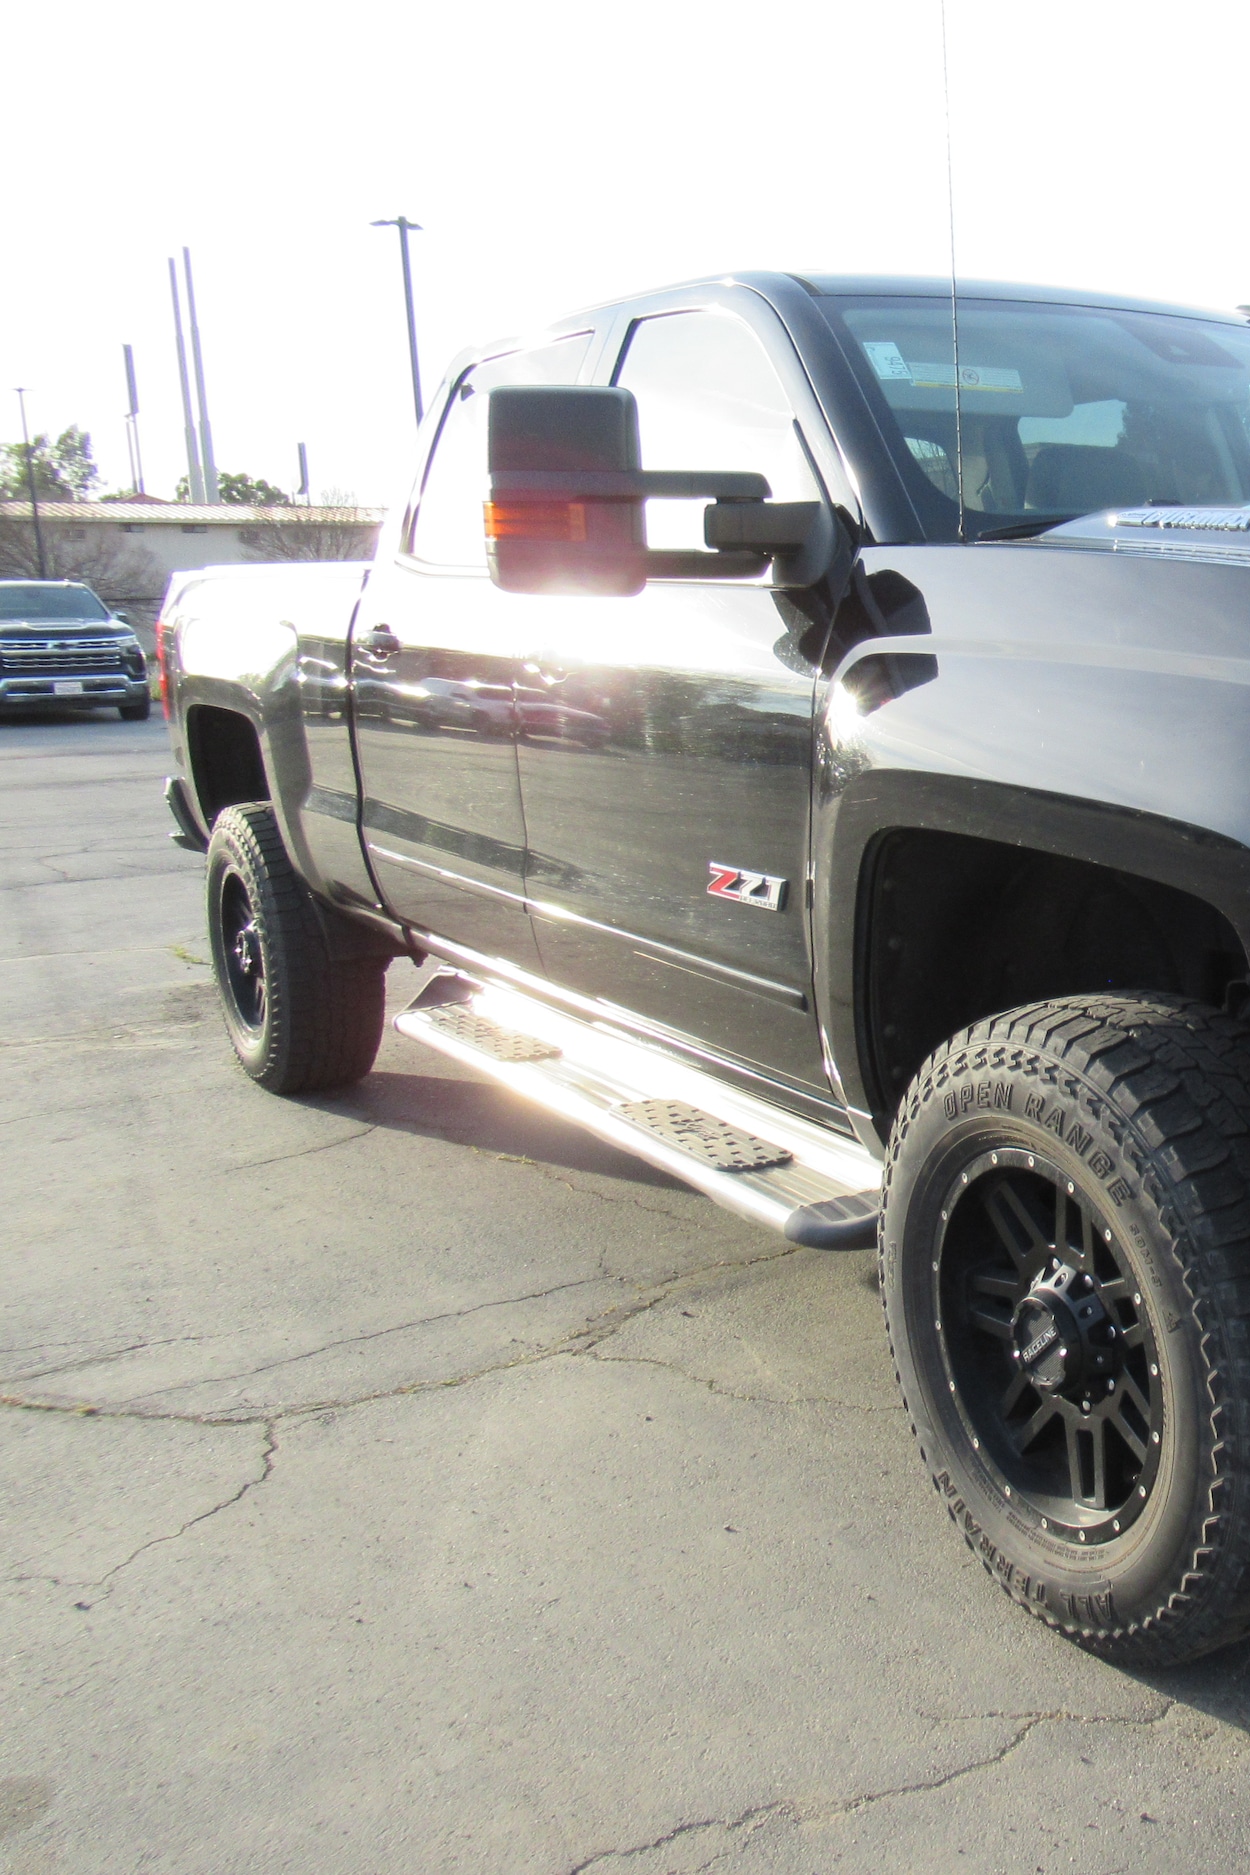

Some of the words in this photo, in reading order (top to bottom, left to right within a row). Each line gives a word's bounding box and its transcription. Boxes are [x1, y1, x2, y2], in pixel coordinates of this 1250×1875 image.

[706, 861, 787, 911] Z71
[943, 1080, 1014, 1120] OPEN
[1024, 1090, 1137, 1207] RANGE
[1022, 1325, 1058, 1363] RACELINE
[937, 1470, 1048, 1608] TERRAIN
[1059, 1588, 1115, 1621] ALL
